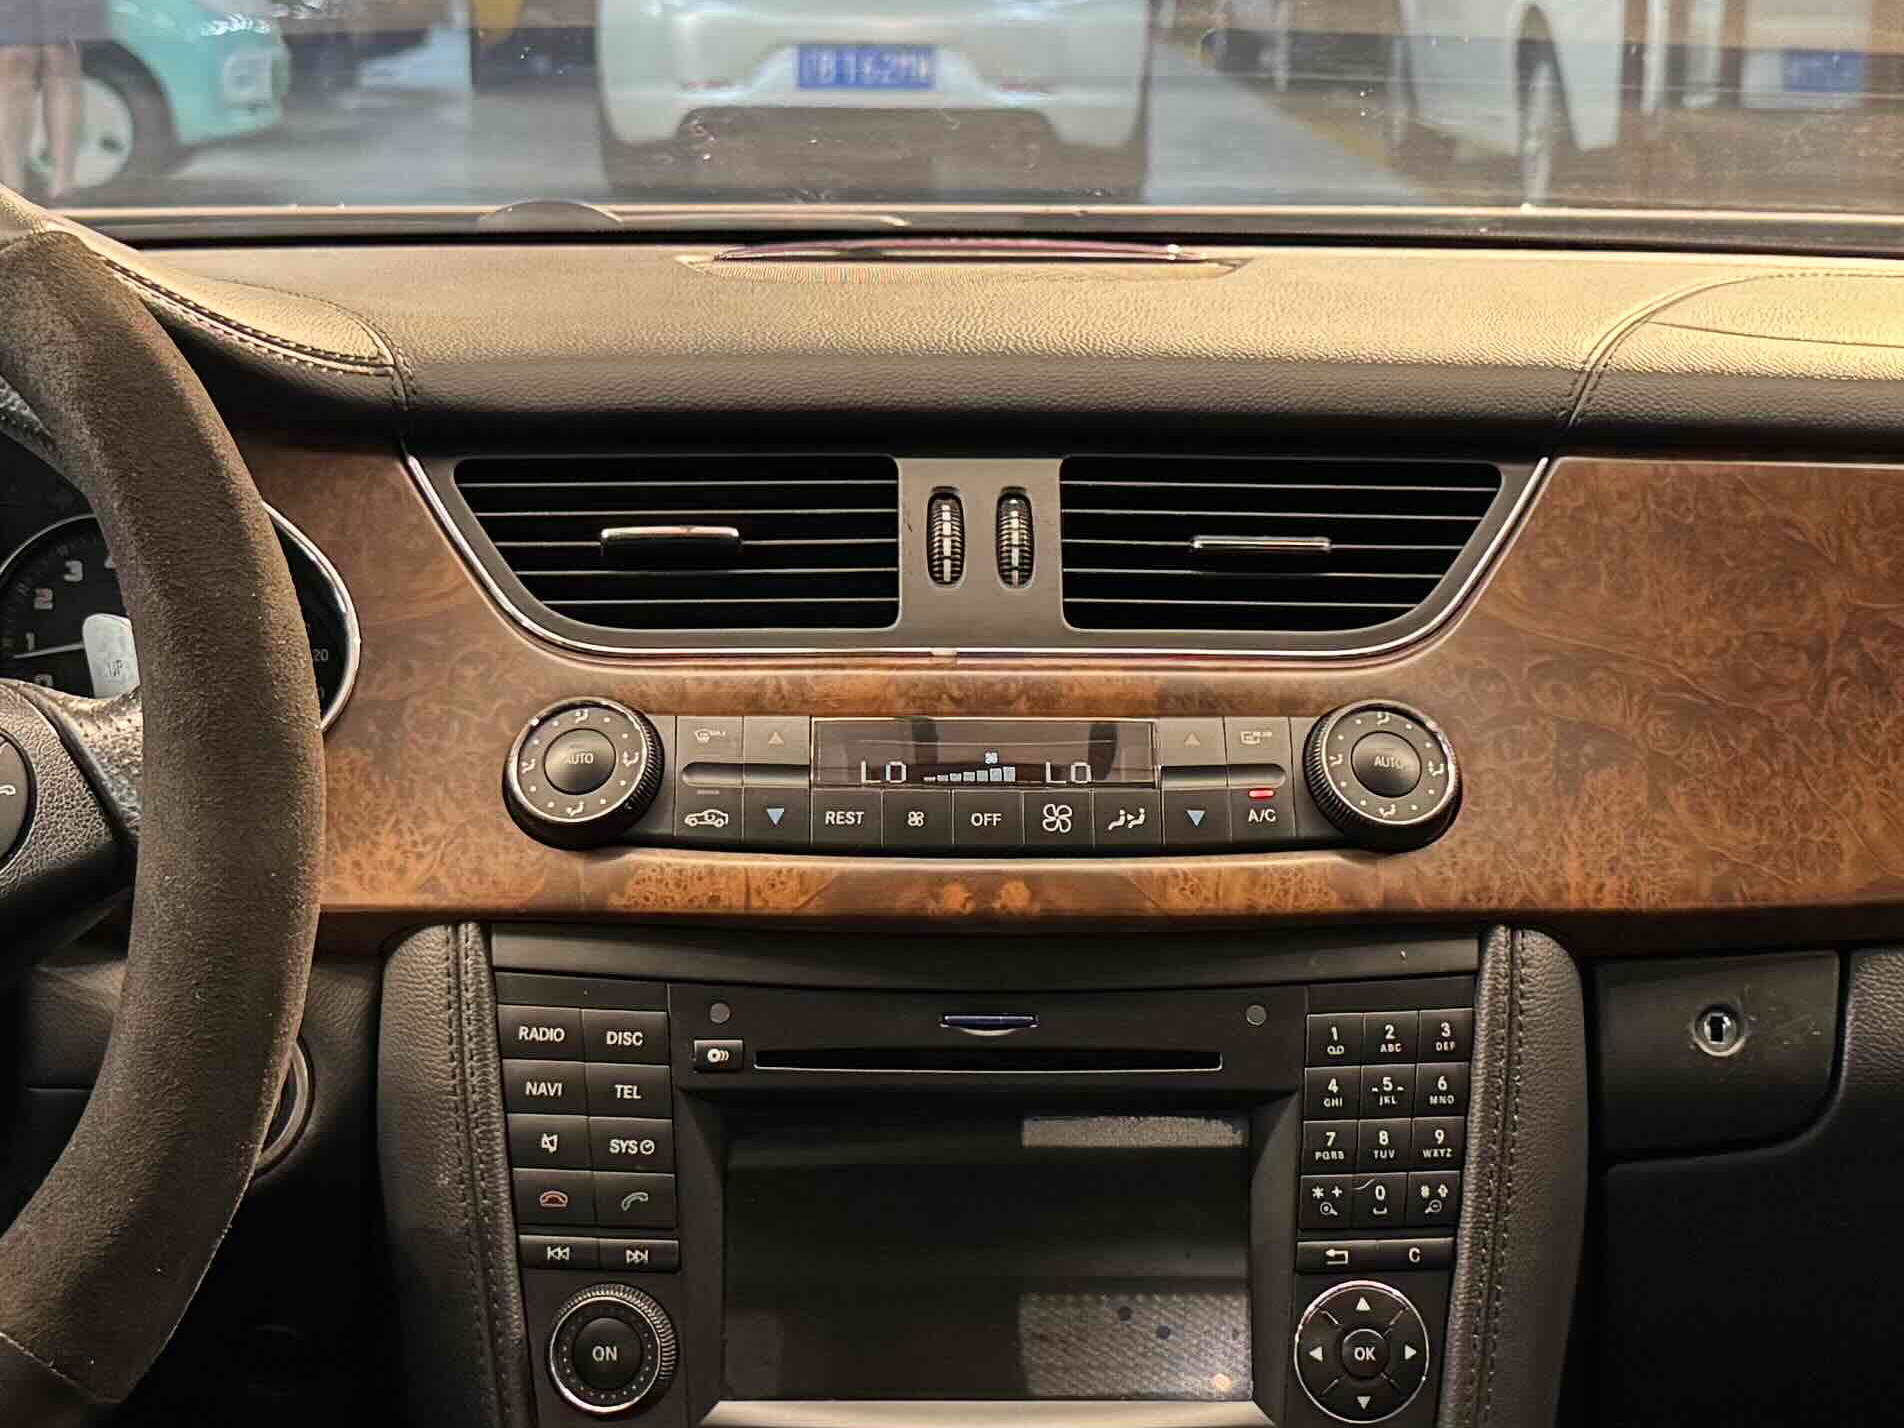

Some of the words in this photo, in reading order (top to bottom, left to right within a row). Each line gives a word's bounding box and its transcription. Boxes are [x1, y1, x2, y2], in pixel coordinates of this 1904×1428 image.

[63, 559, 85, 583] 3
[33, 587, 55, 611] 2
[24, 632, 37, 652] 1
[860, 760, 908, 785] LO
[1045, 762, 1093, 785] LO
[824, 811, 865, 826] REST
[970, 812, 1003, 827] OFF
[1247, 807, 1278, 825] A/C
[518, 1025, 566, 1043] RADIO
[1330, 1025, 1339, 1042] 1
[1384, 1023, 1396, 1040] 2
[1440, 1021, 1452, 1038] 3
[605, 1031, 644, 1047] DISC
[1380, 1043, 1402, 1053] ABC
[525, 1081, 563, 1098] NAVI
[614, 1084, 642, 1100] TEL
[1328, 1078, 1339, 1094] 4
[1437, 1075, 1448, 1092] 6
[1323, 1097, 1343, 1108] GHI
[1379, 1095, 1398, 1107] JKL
[1429, 1094, 1456, 1106] MNO
[1325, 1130, 1337, 1147] 7
[1378, 1129, 1389, 1146] 8
[1434, 1129, 1446, 1145] 9
[609, 1138, 638, 1154] SYS
[1373, 1148, 1396, 1160] TUV
[1375, 1184, 1386, 1201] 0
[1408, 1246, 1422, 1263] C
[591, 1345, 618, 1362] ON
[1353, 1346, 1377, 1362] OK
